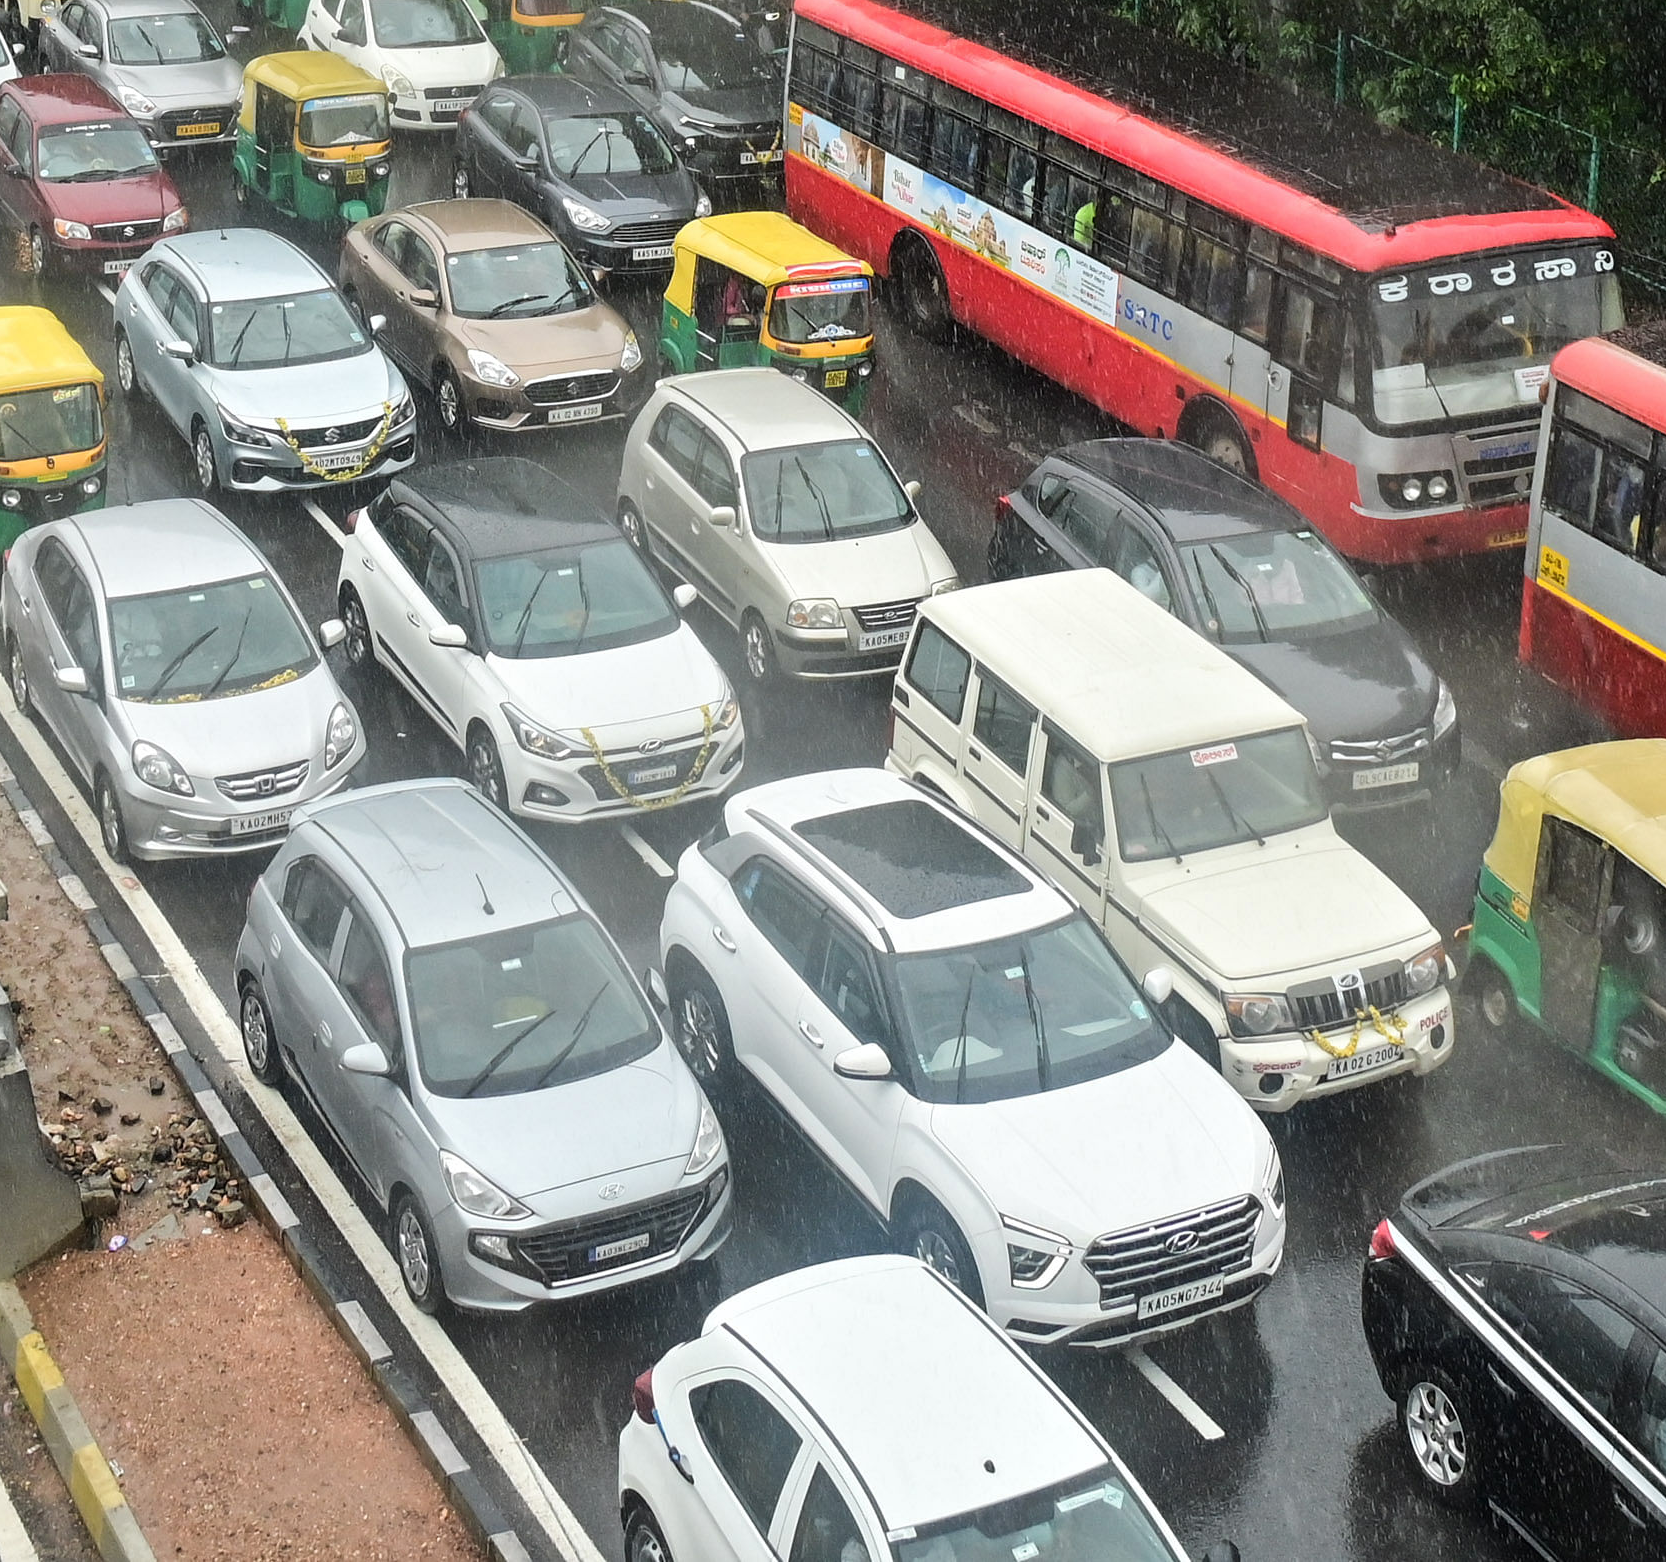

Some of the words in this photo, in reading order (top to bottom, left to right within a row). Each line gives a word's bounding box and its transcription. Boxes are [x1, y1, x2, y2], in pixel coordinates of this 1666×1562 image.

[1115, 295, 1174, 341] SRTC
[311, 455, 360, 468] A02MT0949
[1419, 1007, 1449, 1031] POLICE
[1335, 1062, 1349, 1075] KA
[1352, 1059, 1366, 1071] 02
[1367, 1055, 1374, 1067] G
[1375, 1046, 1401, 1065] 2004
